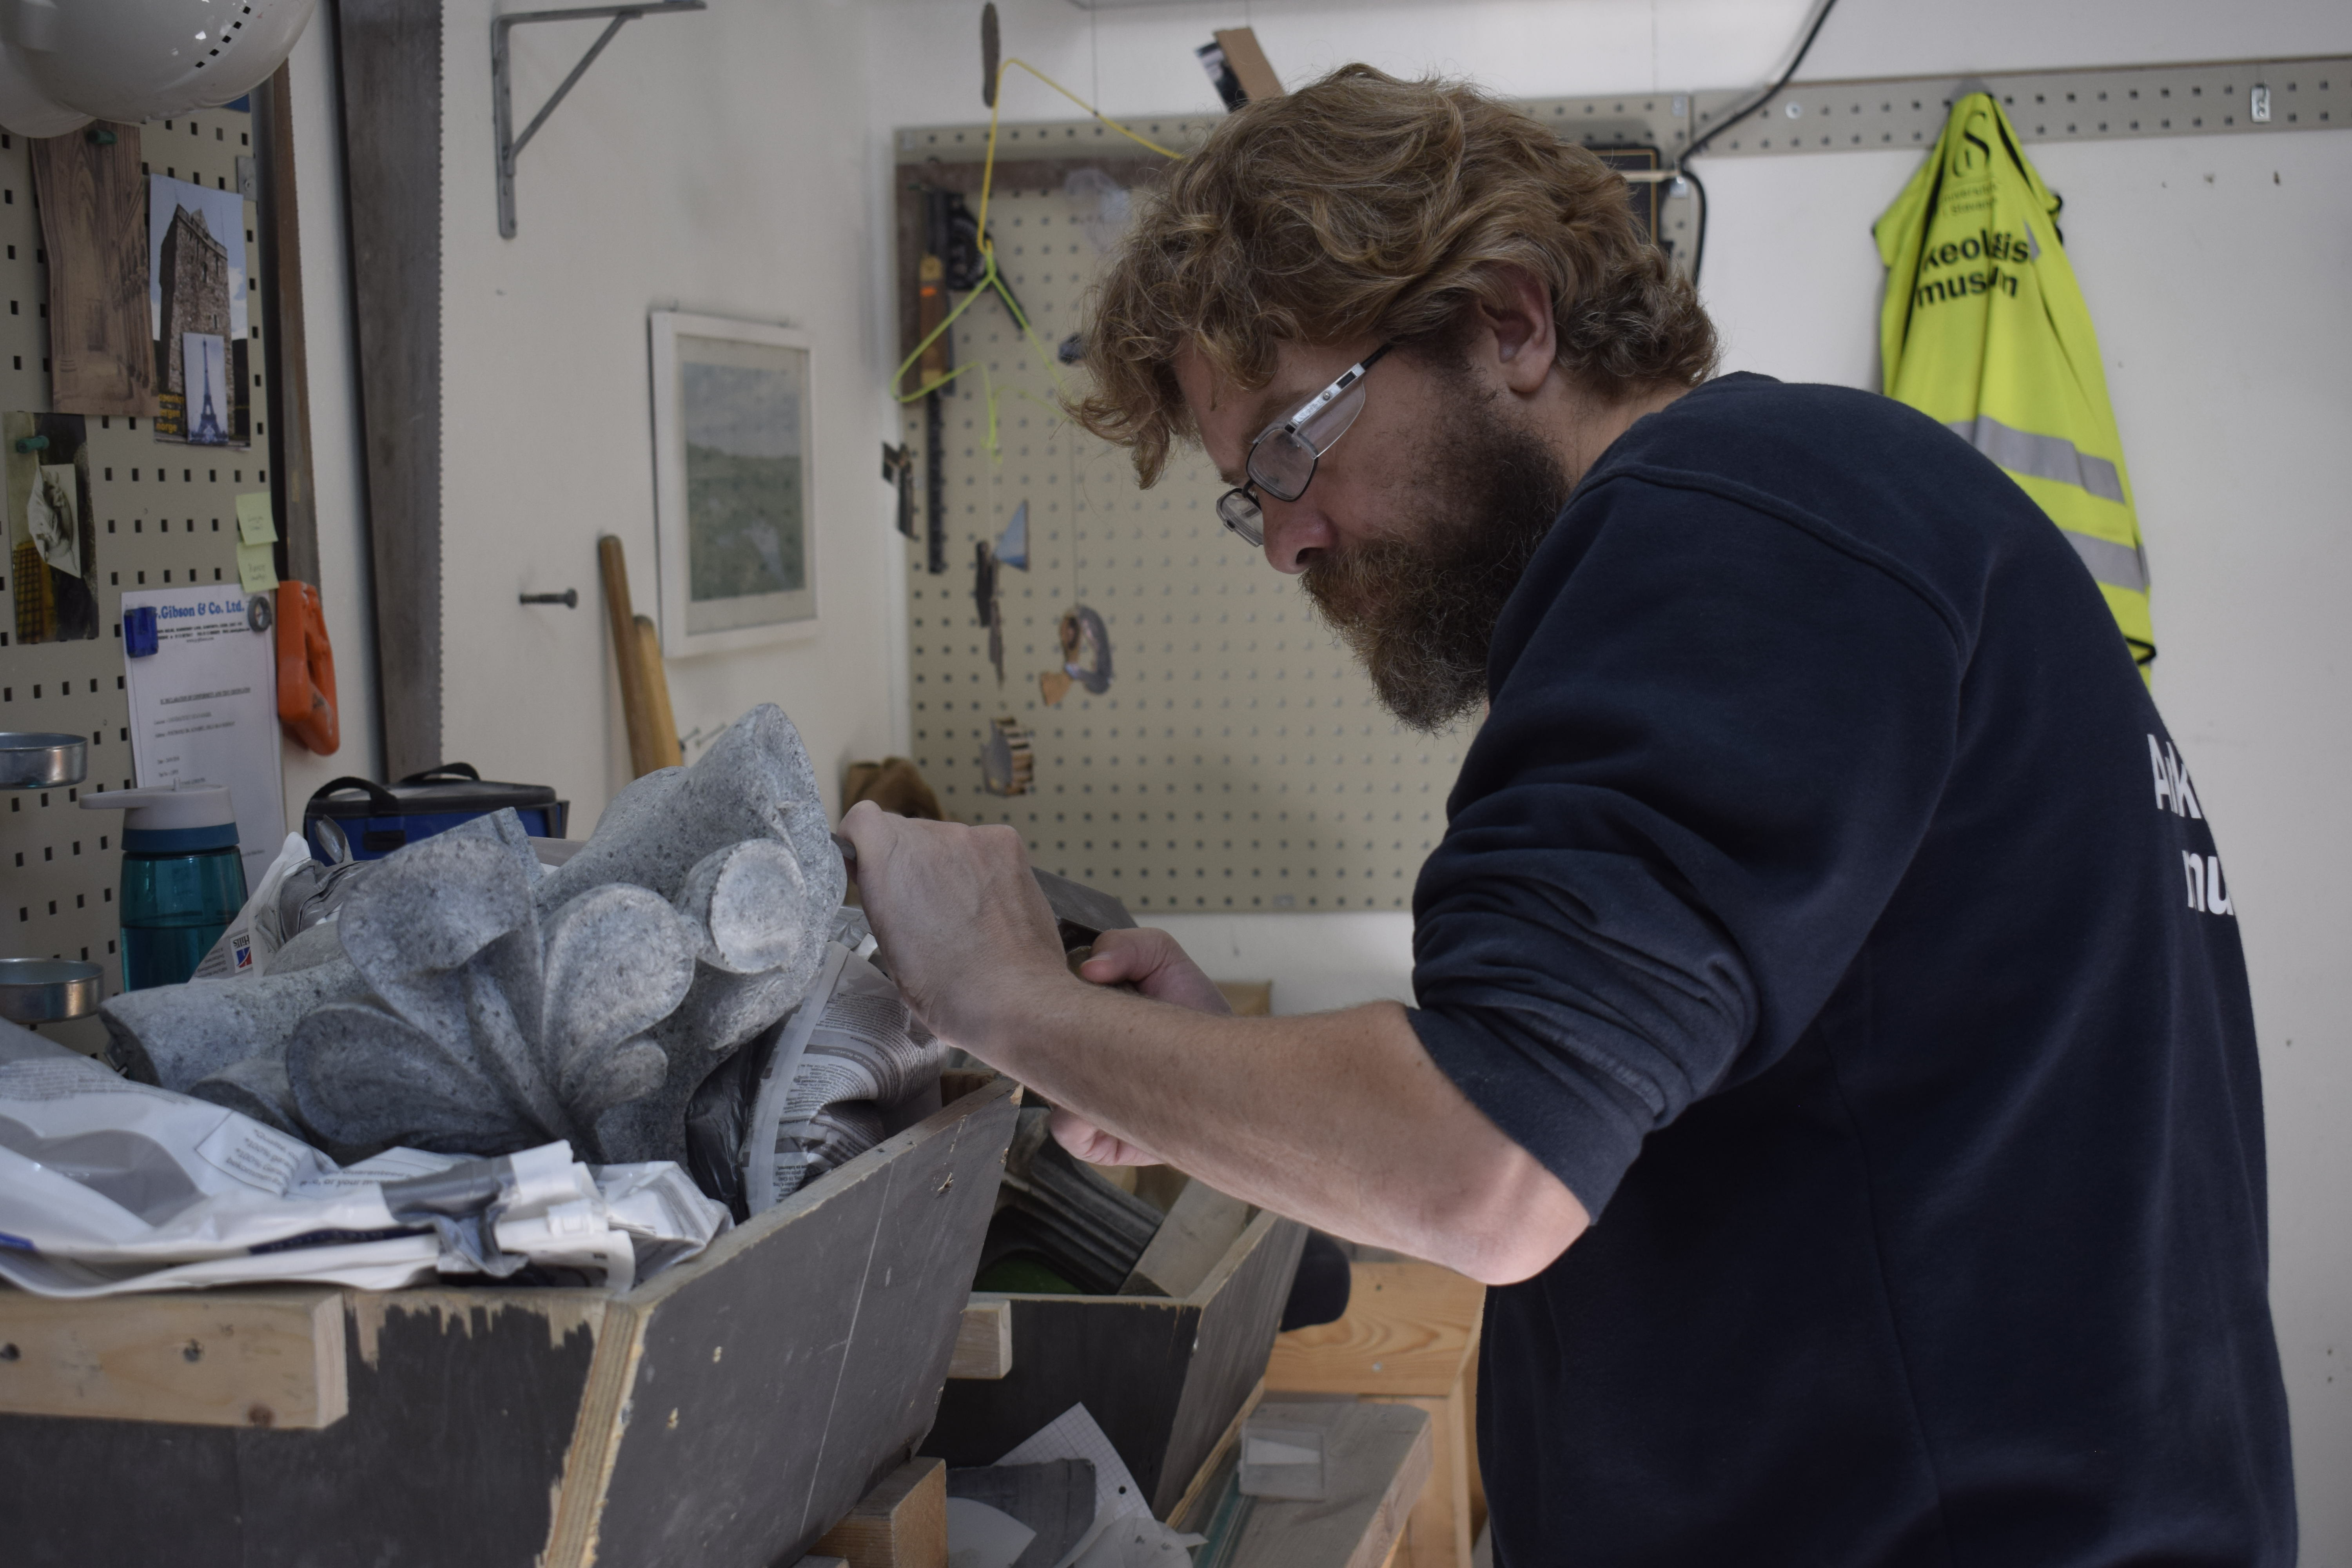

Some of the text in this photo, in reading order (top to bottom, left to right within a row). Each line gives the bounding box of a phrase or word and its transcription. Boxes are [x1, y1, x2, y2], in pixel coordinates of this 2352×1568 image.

[198, 603, 206, 616] &
[209, 602, 223, 614] Co.
[226, 600, 245, 613] Ltd.
